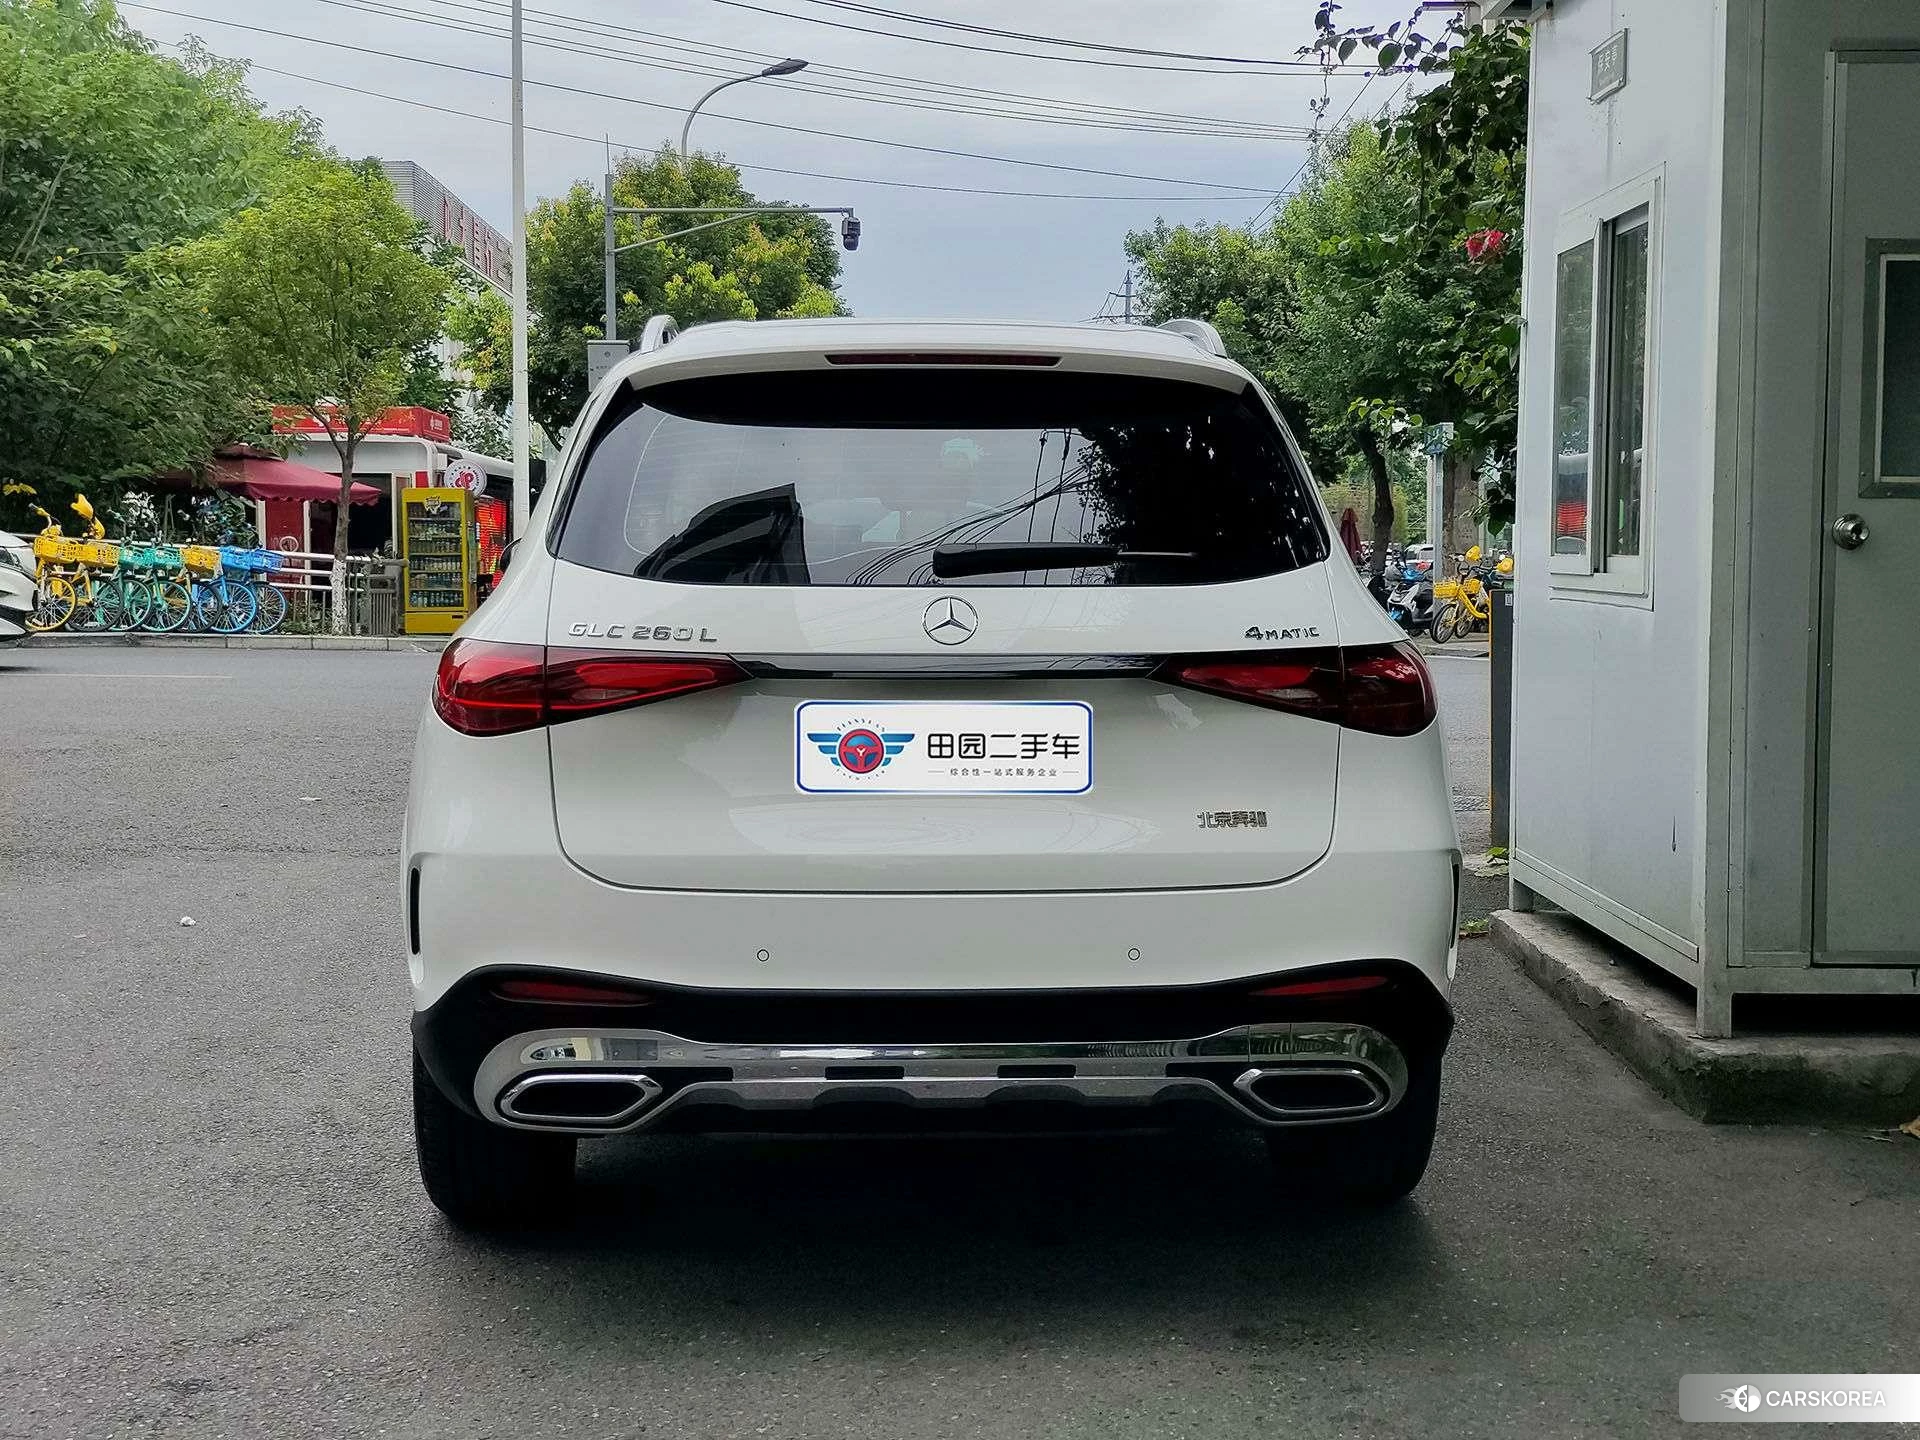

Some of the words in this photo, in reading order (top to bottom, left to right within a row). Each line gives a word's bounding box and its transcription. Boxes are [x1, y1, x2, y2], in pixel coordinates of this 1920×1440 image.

[568, 621, 625, 639] GLC
[631, 625, 693, 642] 260
[699, 627, 718, 643] L
[1244, 626, 1320, 641] 4MATIC
[927, 732, 1081, 760] 田园二手车
[949, 767, 1058, 778] 综合性一站式服务企业
